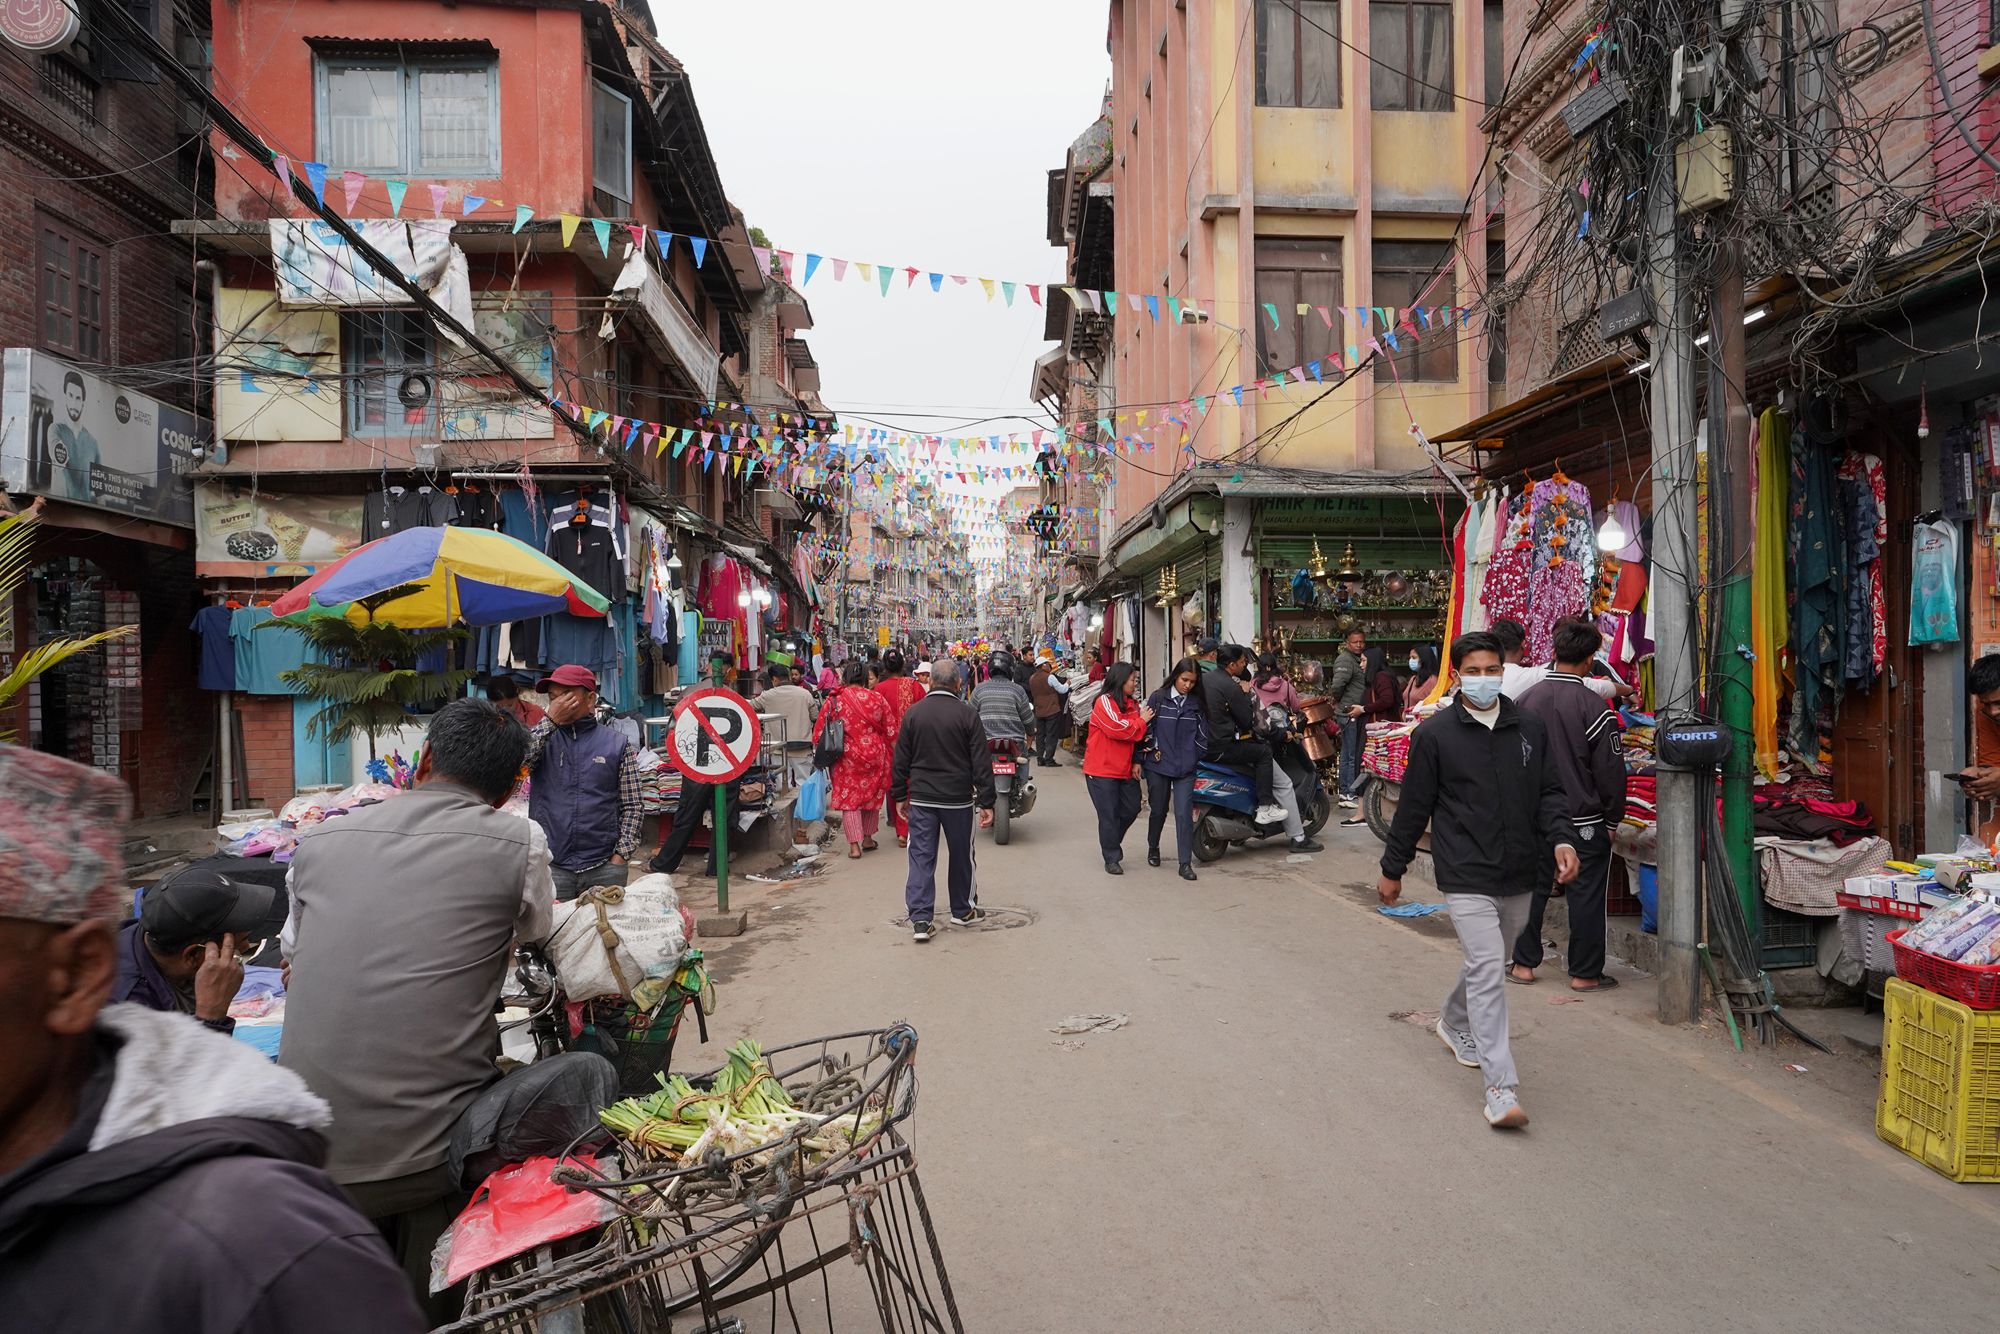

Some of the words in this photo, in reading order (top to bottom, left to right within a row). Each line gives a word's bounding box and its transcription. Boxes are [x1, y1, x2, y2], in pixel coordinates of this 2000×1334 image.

[19, 30, 38, 40] Food
[45, 17, 61, 36] Drinks
[116, 402, 130, 411] NIVEA
[117, 409, 129, 418] MEN
[91, 469, 107, 480] MEN,
[108, 473, 122, 483] THIS
[123, 476, 144, 489] WINTER
[91, 480, 103, 490] USE
[104, 483, 121, 494] YOUR
[1313, 497, 1369, 511] METAL
[220, 512, 251, 524] BUTTER
[696, 707, 743, 767] P
